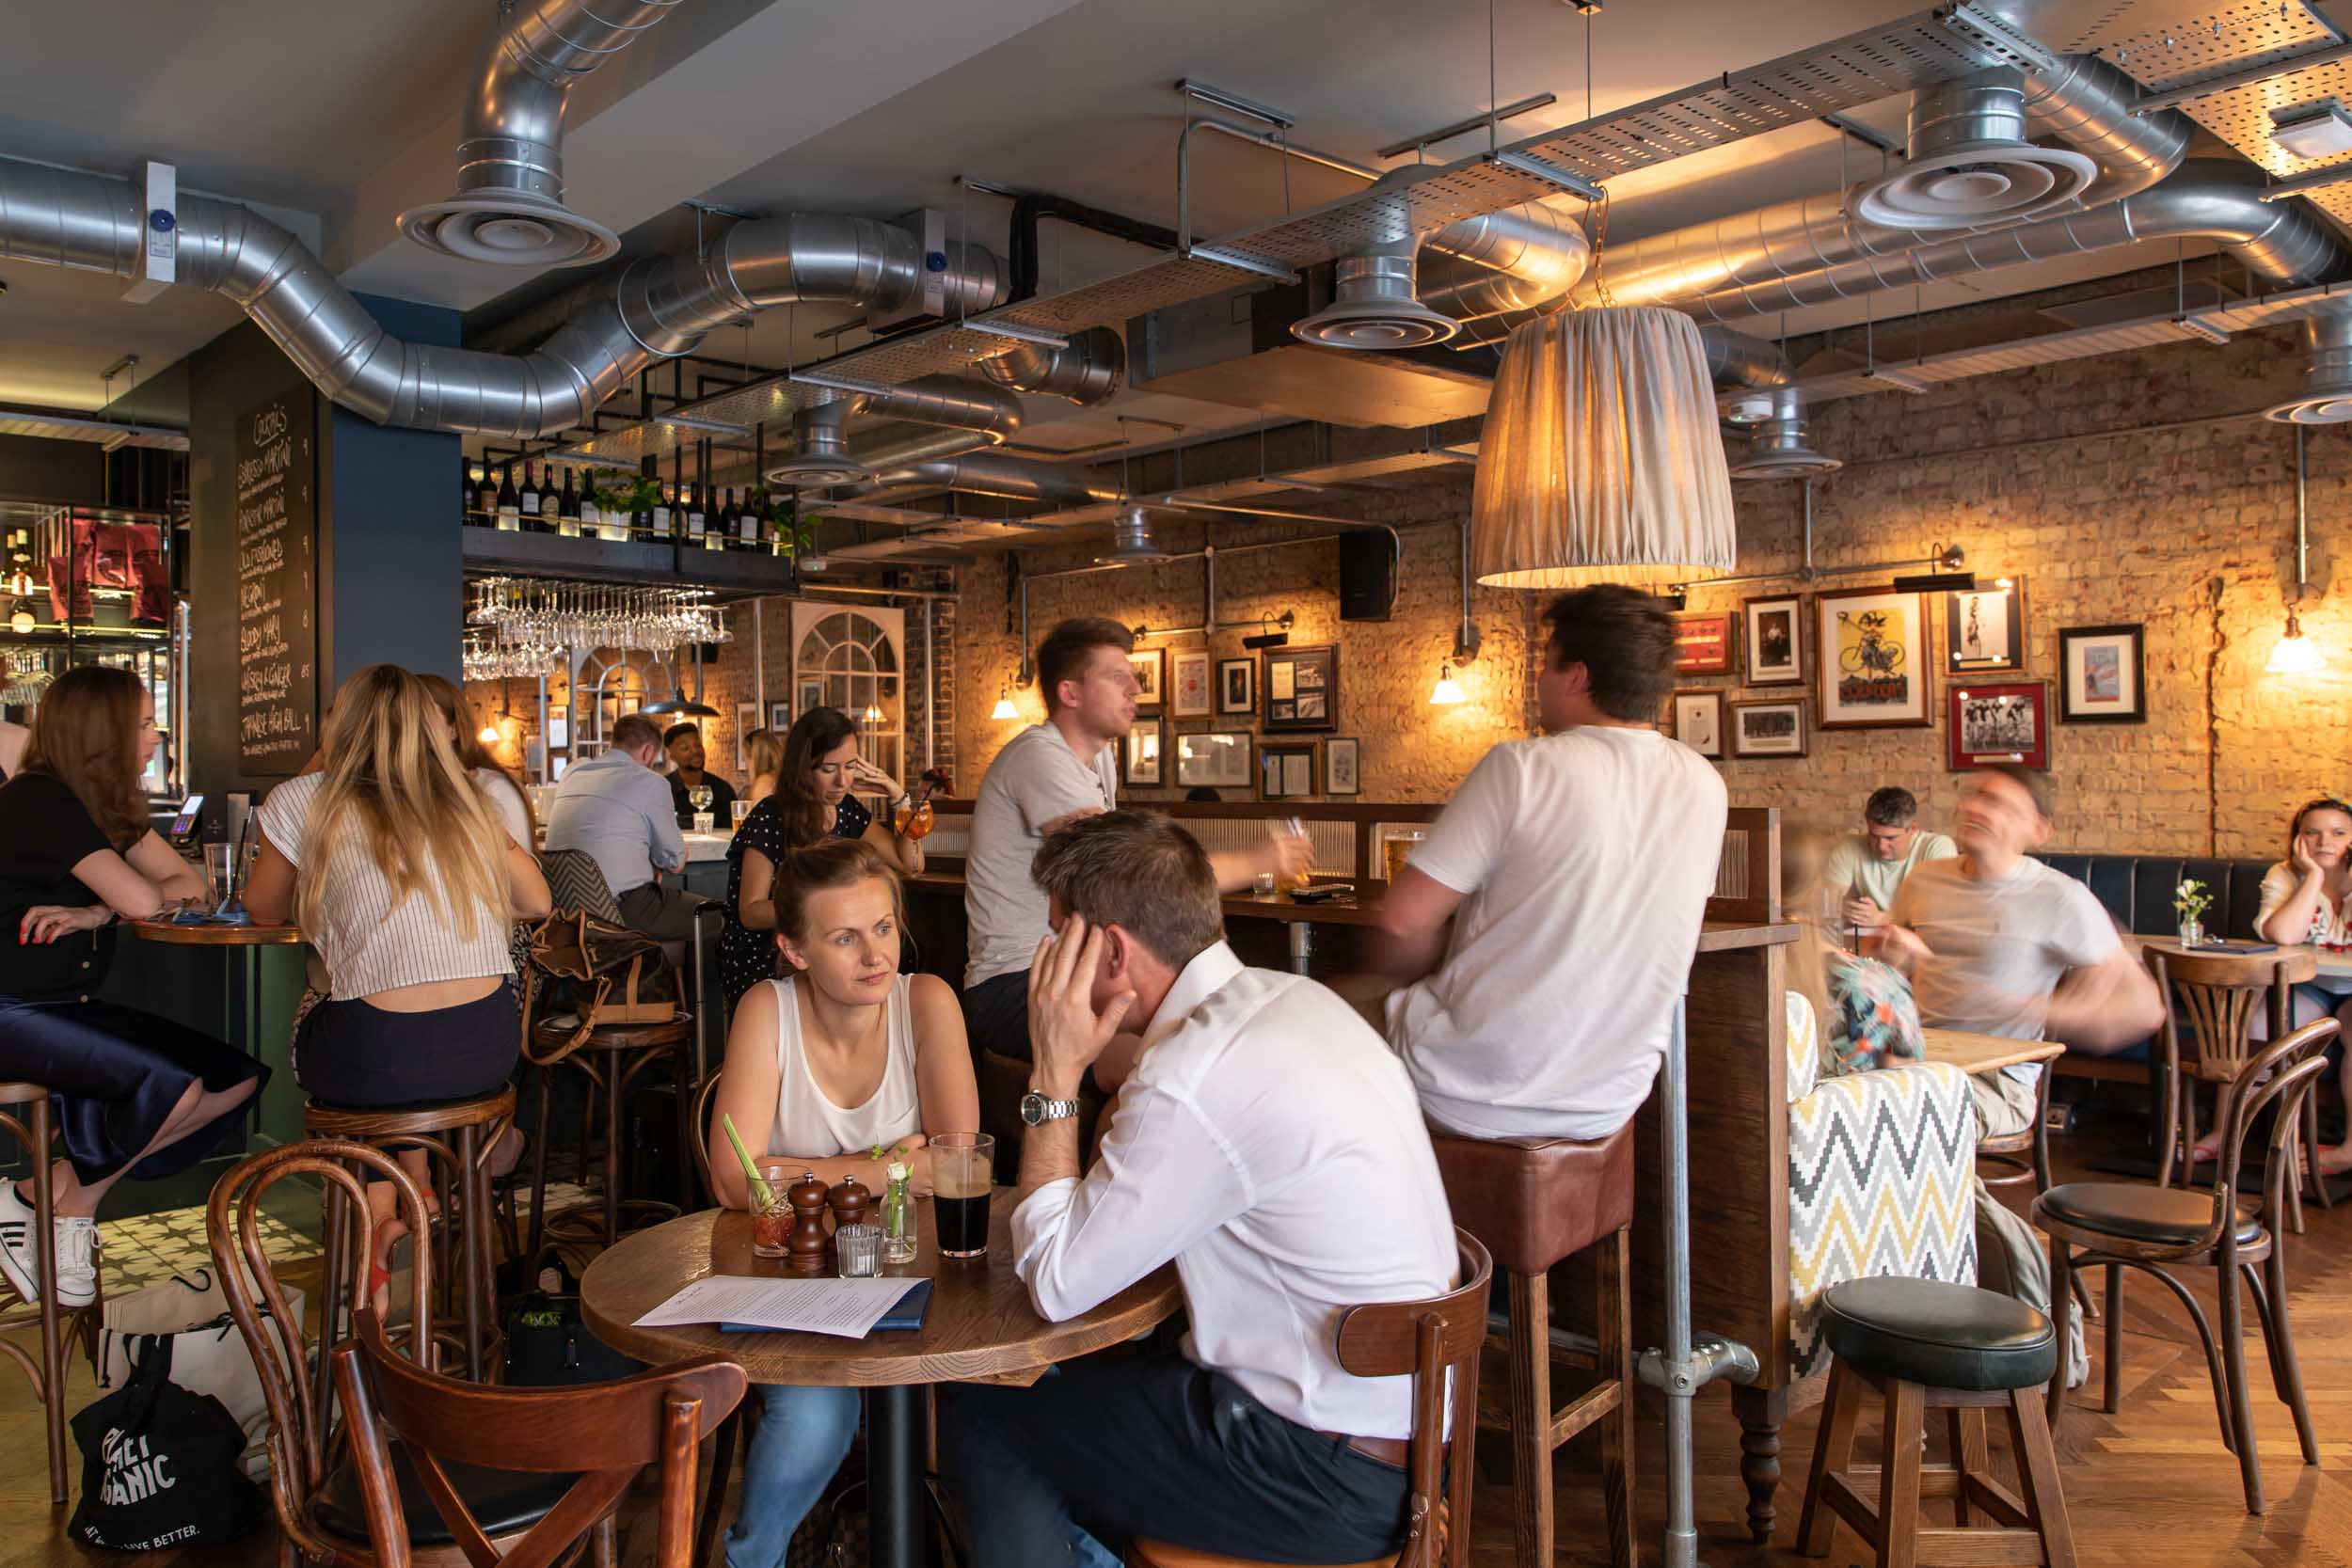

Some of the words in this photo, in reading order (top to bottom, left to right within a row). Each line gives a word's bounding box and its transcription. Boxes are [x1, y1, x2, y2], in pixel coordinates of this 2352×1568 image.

[240, 626, 262, 654] BLOODY
[263, 613, 281, 646] MARY
[152, 1524, 200, 1548] BETTER.
